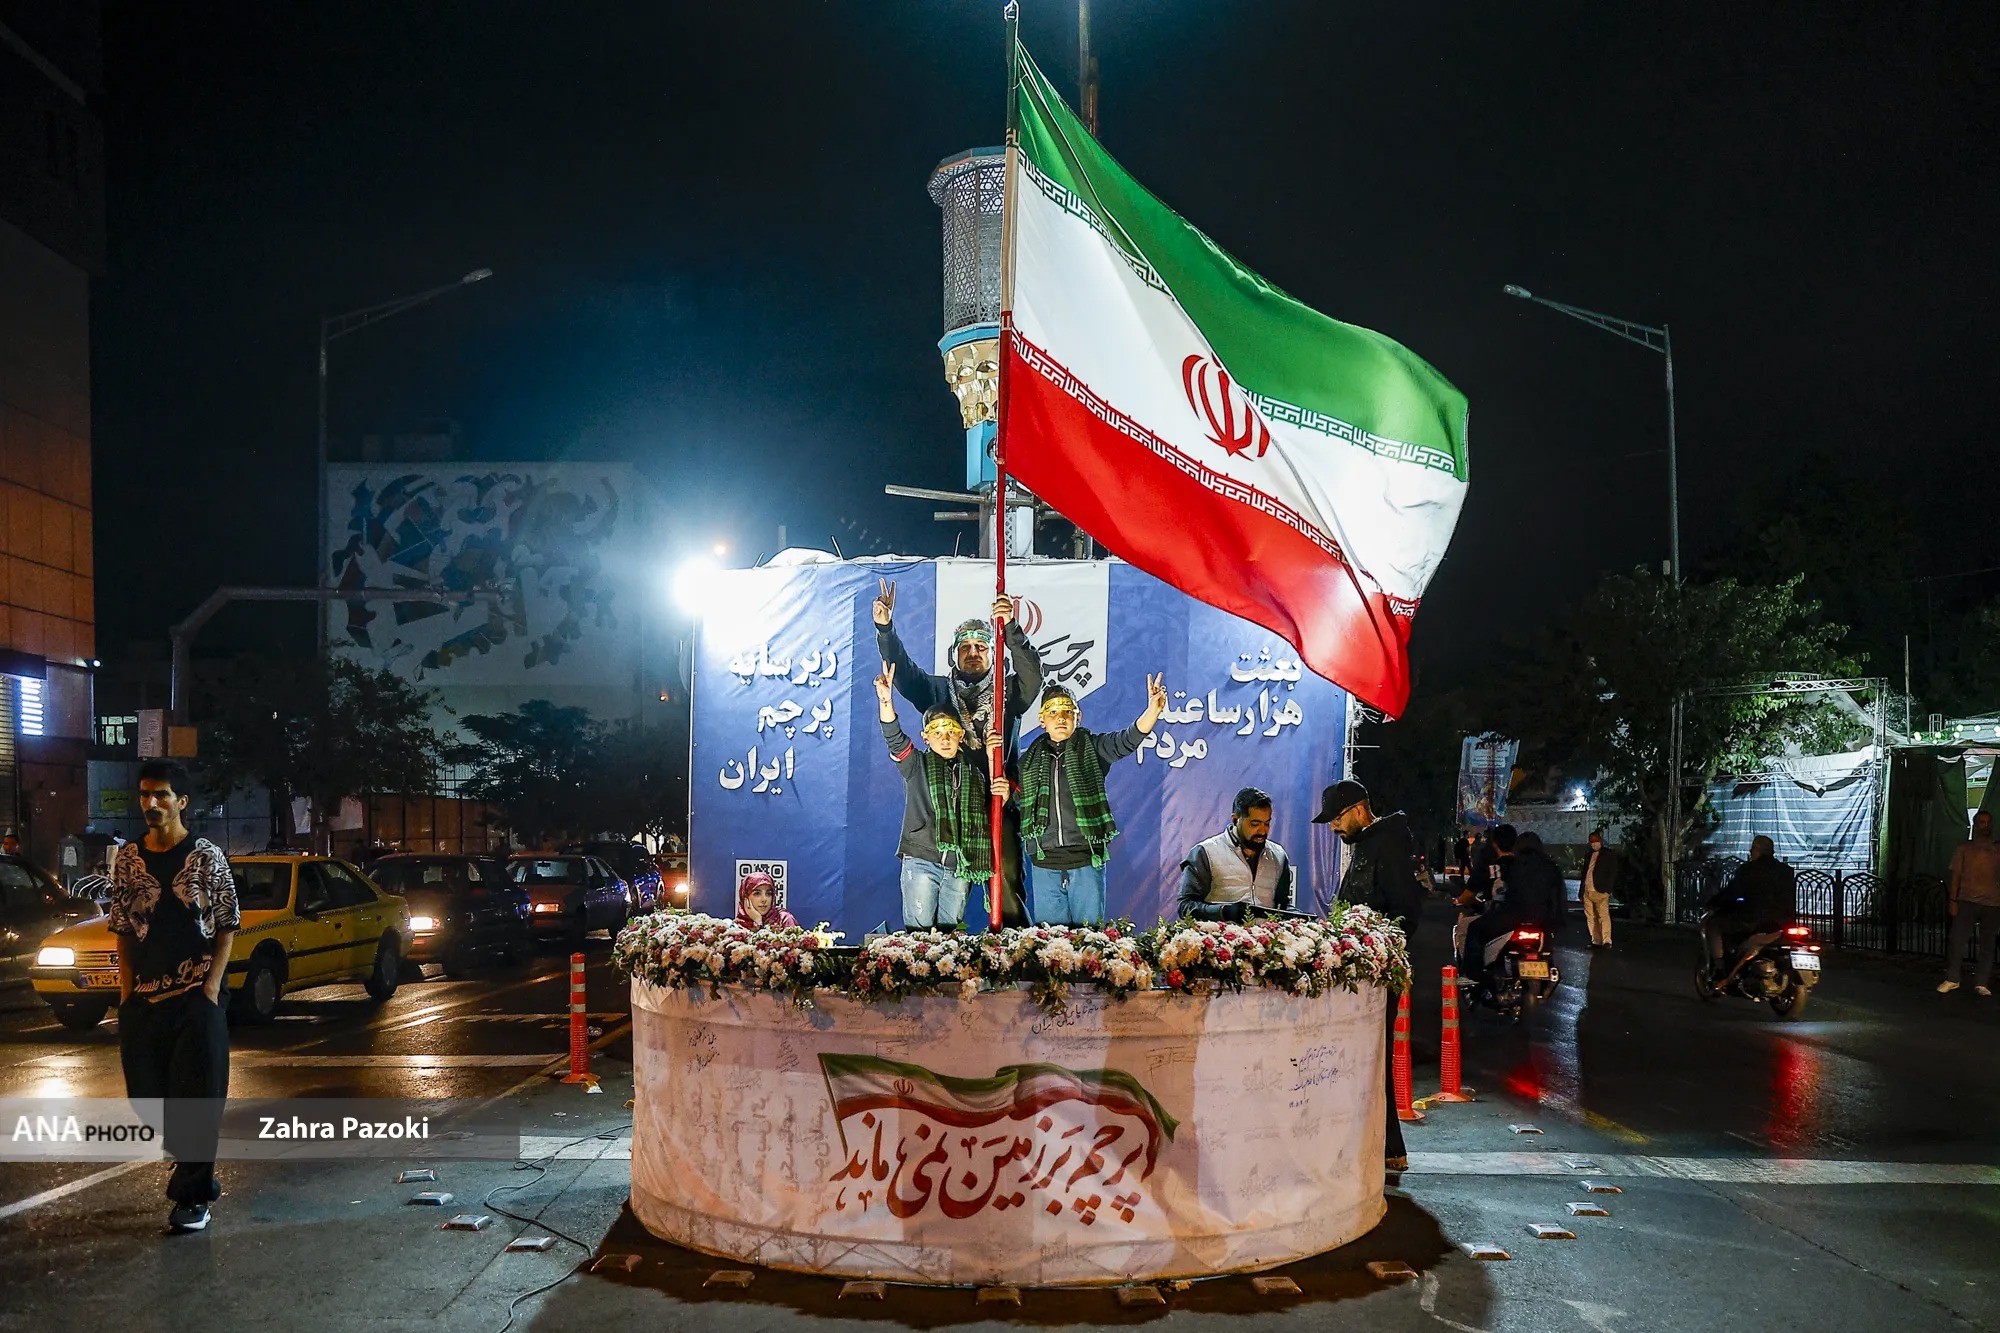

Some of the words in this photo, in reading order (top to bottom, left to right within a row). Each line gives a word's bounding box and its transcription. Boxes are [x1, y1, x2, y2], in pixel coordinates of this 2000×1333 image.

[729, 640, 791, 685] سایه
[791, 638, 837, 687] زیر
[1230, 646, 1302, 691] بعثت
[757, 697, 834, 739] پرچم
[719, 745, 795, 794] ایران
[1136, 730, 1208, 768] مردم
[938, 1116, 1052, 1219] زمین
[1066, 1125, 1143, 1226] پرچم
